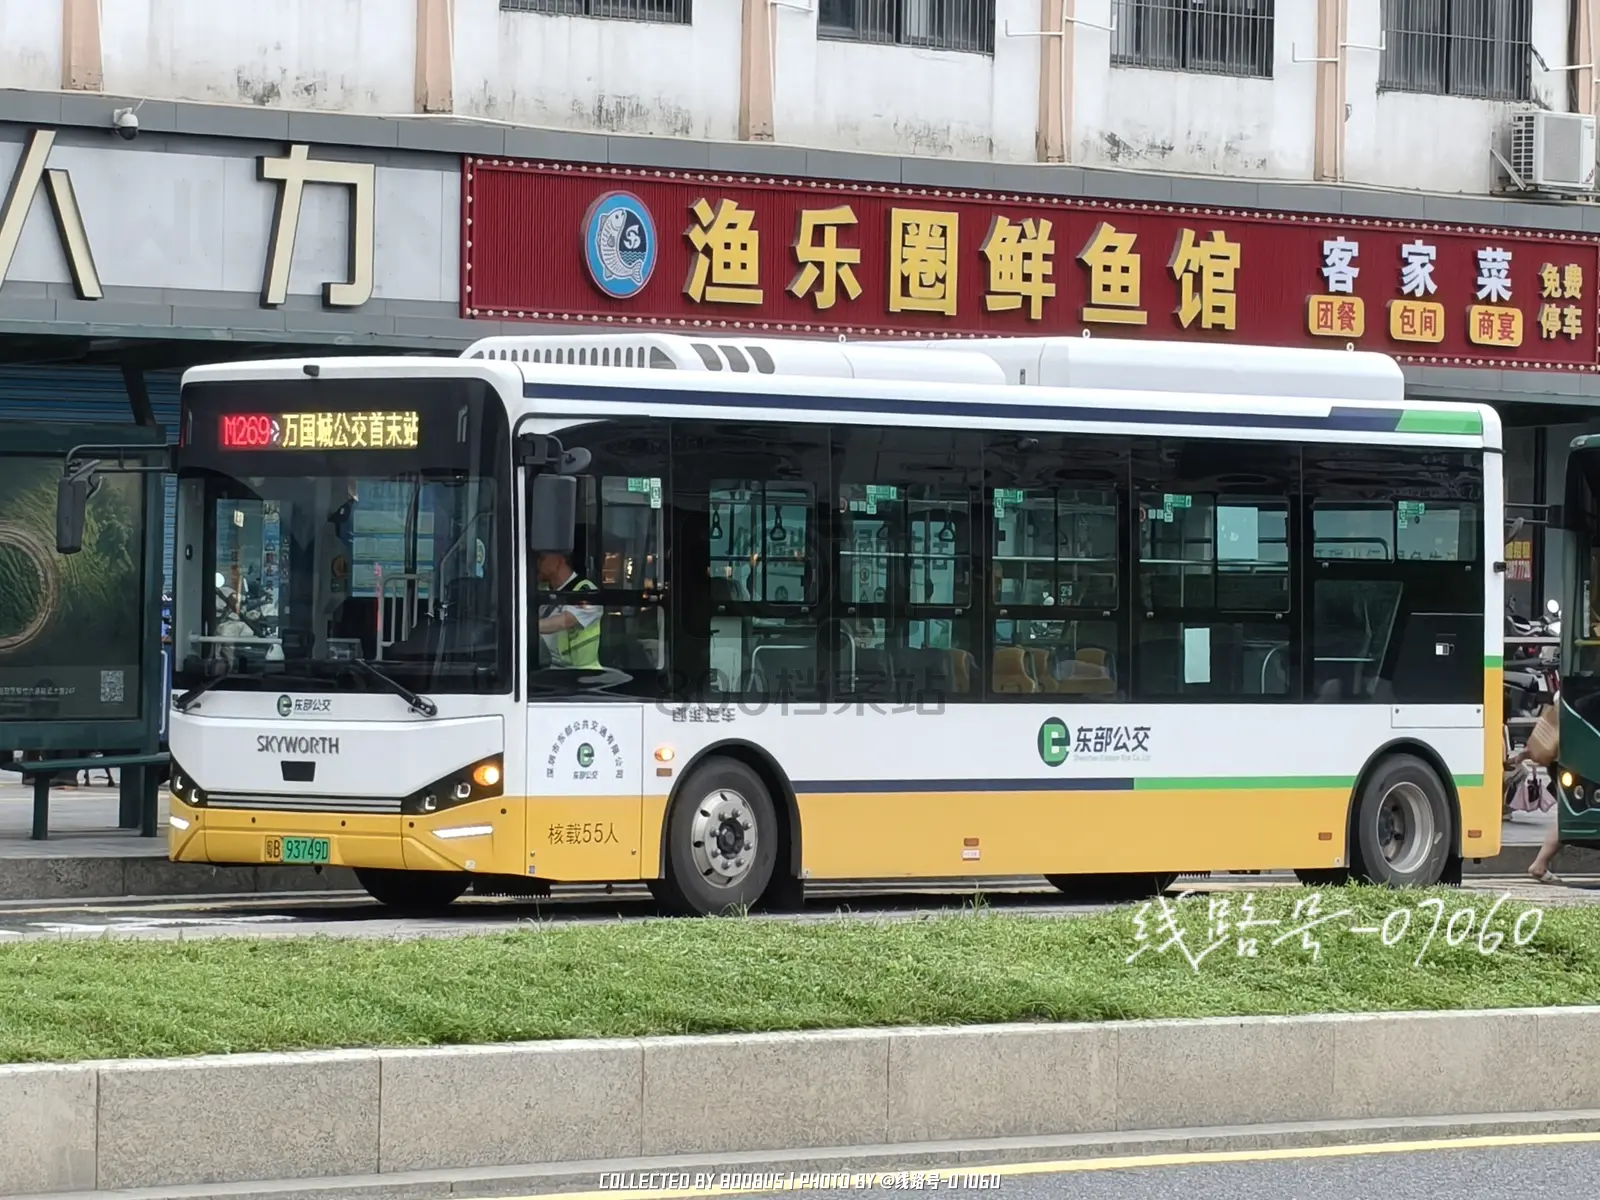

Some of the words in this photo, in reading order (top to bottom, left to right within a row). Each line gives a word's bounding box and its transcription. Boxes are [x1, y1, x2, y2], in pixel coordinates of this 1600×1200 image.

[684, 198, 1241, 331] 渔乐圈鲜鱼馆
[1321, 236, 1513, 303] 客家菜
[1539, 262, 1583, 300] 免费
[1316, 301, 1356, 331] 团餐
[1399, 305, 1438, 337] 包间
[1477, 310, 1516, 342] 商宴
[1539, 303, 1583, 340] 停车
[224, 415, 272, 446] M269
[281, 411, 420, 448] 万国城公交首末站
[294, 698, 332, 712] 东部公交
[257, 735, 340, 755] SKYWORTH
[1074, 726, 1151, 752] 东部公交
[548, 822, 619, 845] 核载55人
